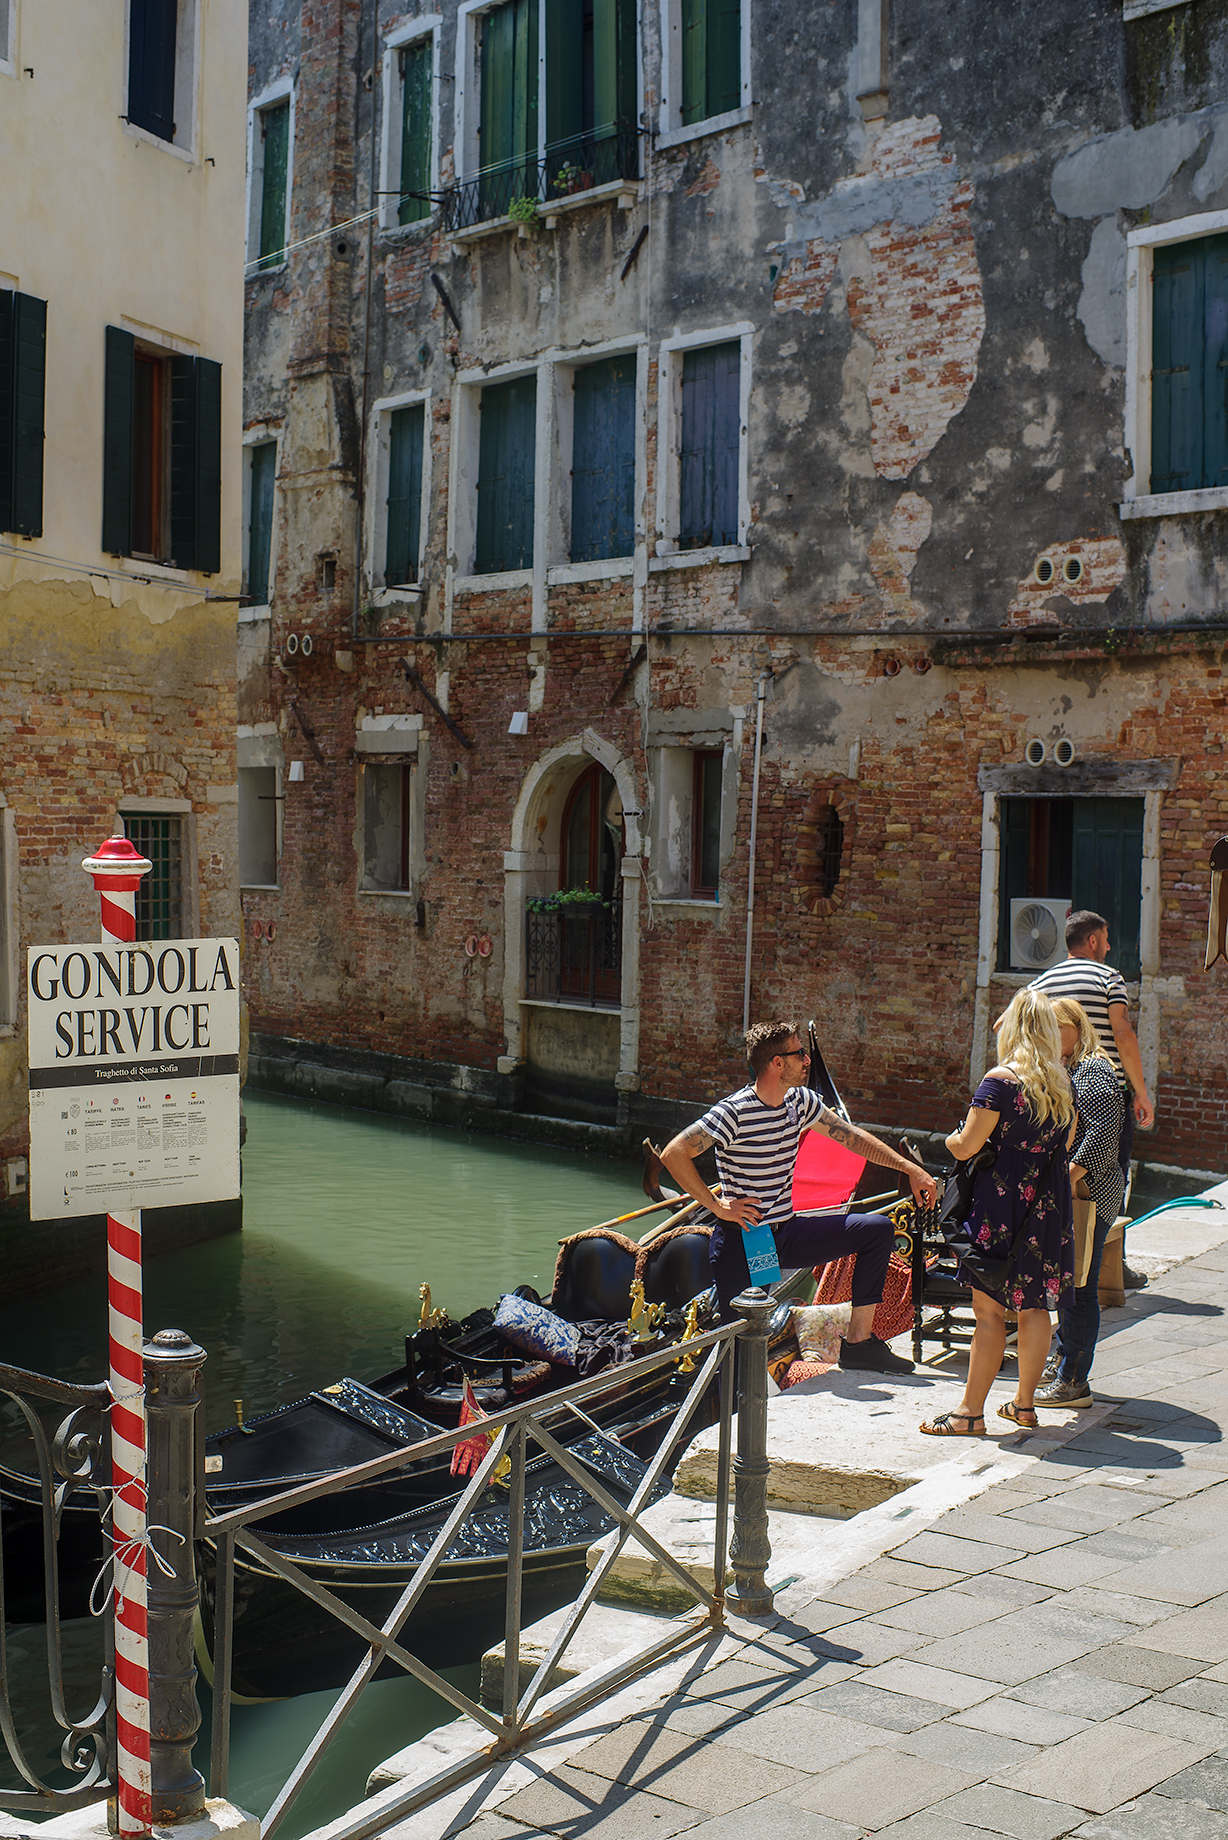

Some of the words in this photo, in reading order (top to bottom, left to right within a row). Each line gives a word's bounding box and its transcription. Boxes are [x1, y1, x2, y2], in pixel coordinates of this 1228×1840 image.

[31, 945, 236, 1001] GONDOLA
[55, 1003, 211, 1059] SERVICE
[94, 1068, 130, 1079] Traghetto
[130, 1066, 138, 1076] di
[139, 1066, 159, 1075] Santa
[160, 1063, 179, 1073] Sofia
